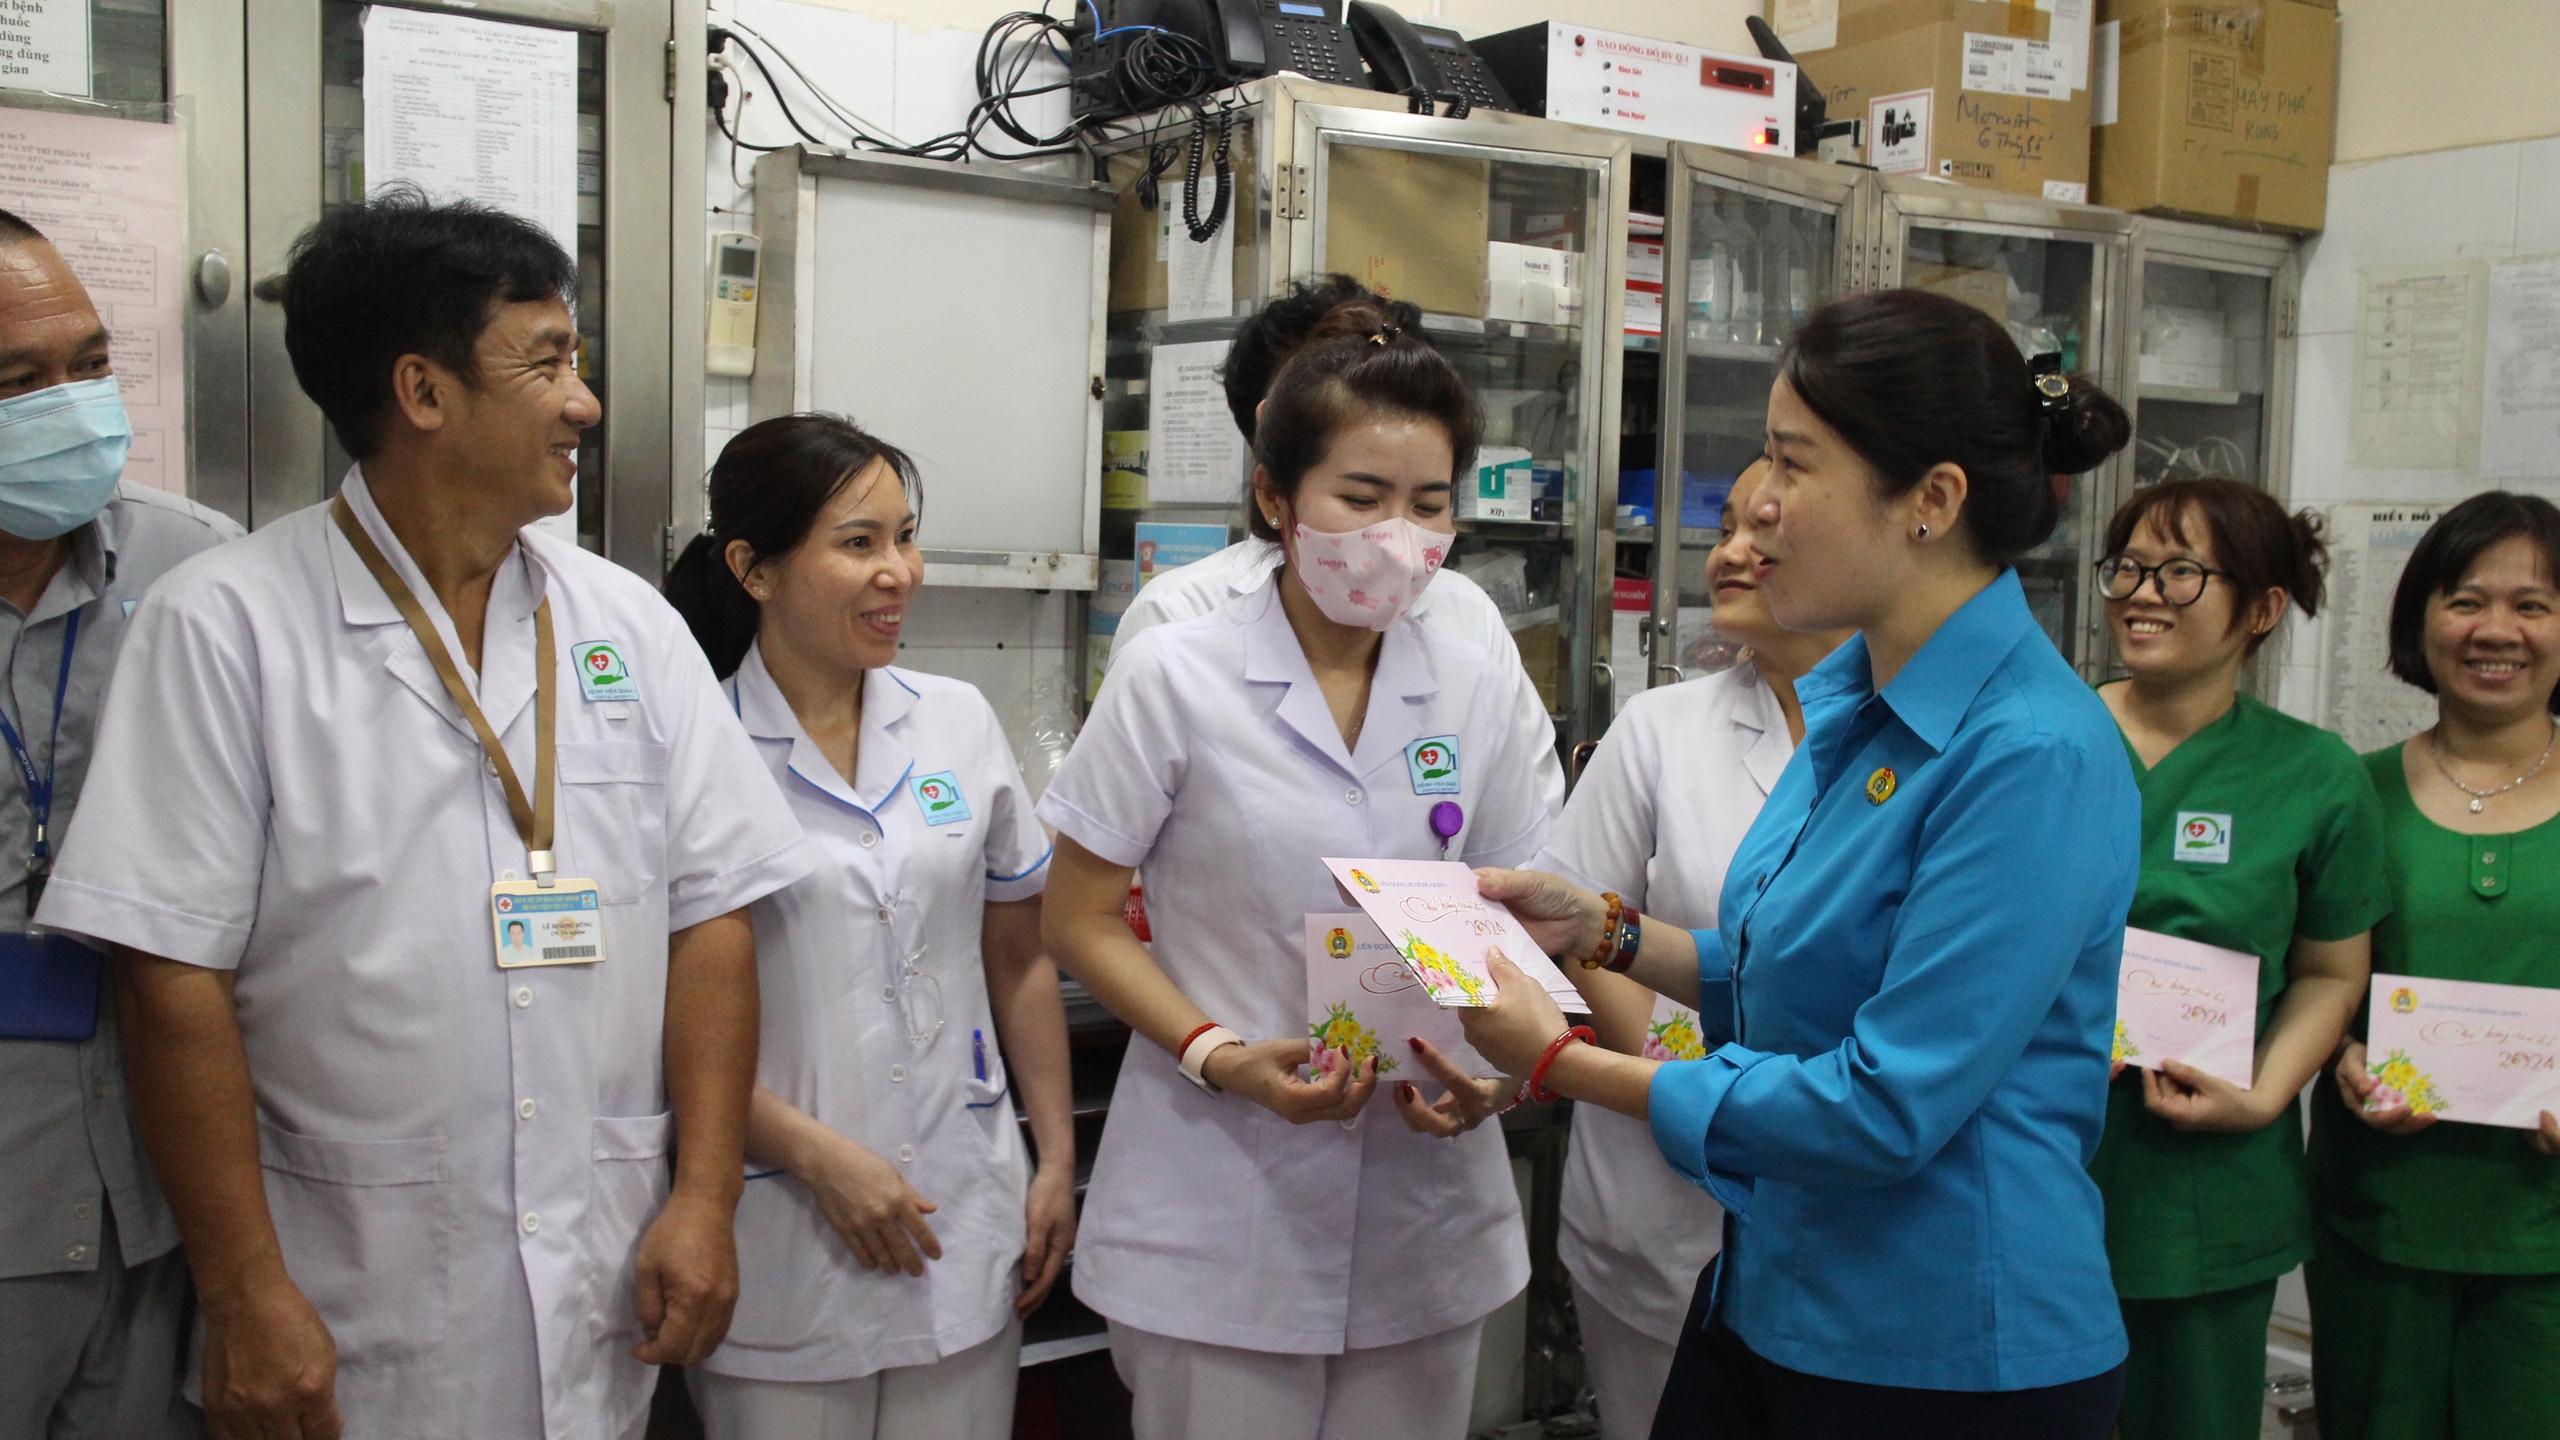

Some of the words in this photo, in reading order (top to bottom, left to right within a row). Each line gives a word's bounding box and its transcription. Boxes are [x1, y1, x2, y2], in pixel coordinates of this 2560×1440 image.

[12, 0, 43, 14] bệnh
[17, 48, 50, 63] dùng
[1597, 38, 1617, 50] BÁO
[1618, 42, 1644, 55] ĐỘNG
[1661, 50, 1673, 59] BV
[2, 63, 29, 75] gian
[1618, 65, 1631, 74] Khoa
[1618, 88, 1631, 97] Khoa
[1617, 109, 1630, 118] Khoa
[1978, 127, 1992, 148] 6
[2181, 1003, 2227, 1027] 2024
[2499, 1050, 2554, 1071] 2024
